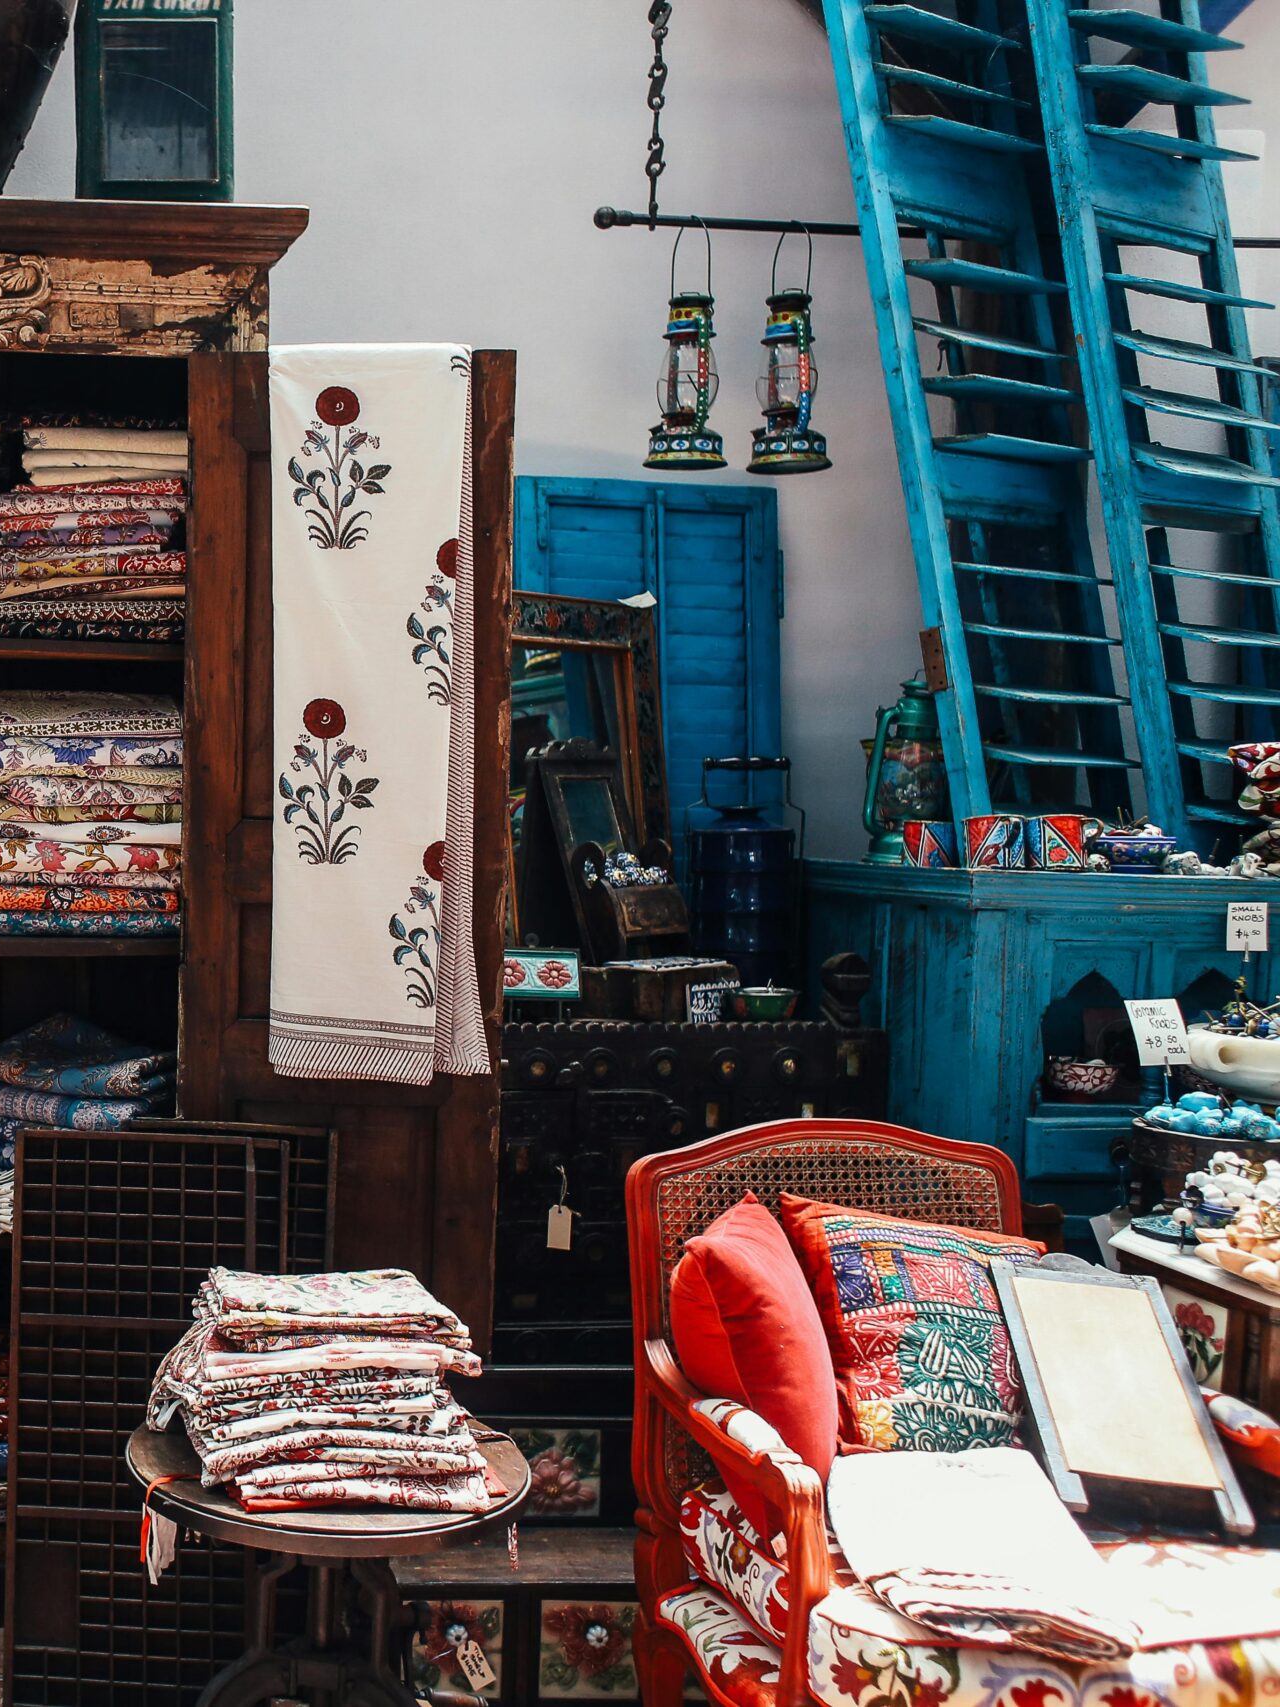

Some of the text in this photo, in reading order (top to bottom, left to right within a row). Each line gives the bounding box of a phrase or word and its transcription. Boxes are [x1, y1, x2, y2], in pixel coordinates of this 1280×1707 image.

[1231, 905, 1262, 913] SMALL
[1231, 914, 1265, 923] KNOBS
[1130, 1001, 1167, 1018] Ceramic
[1167, 1044, 1187, 1054] each
